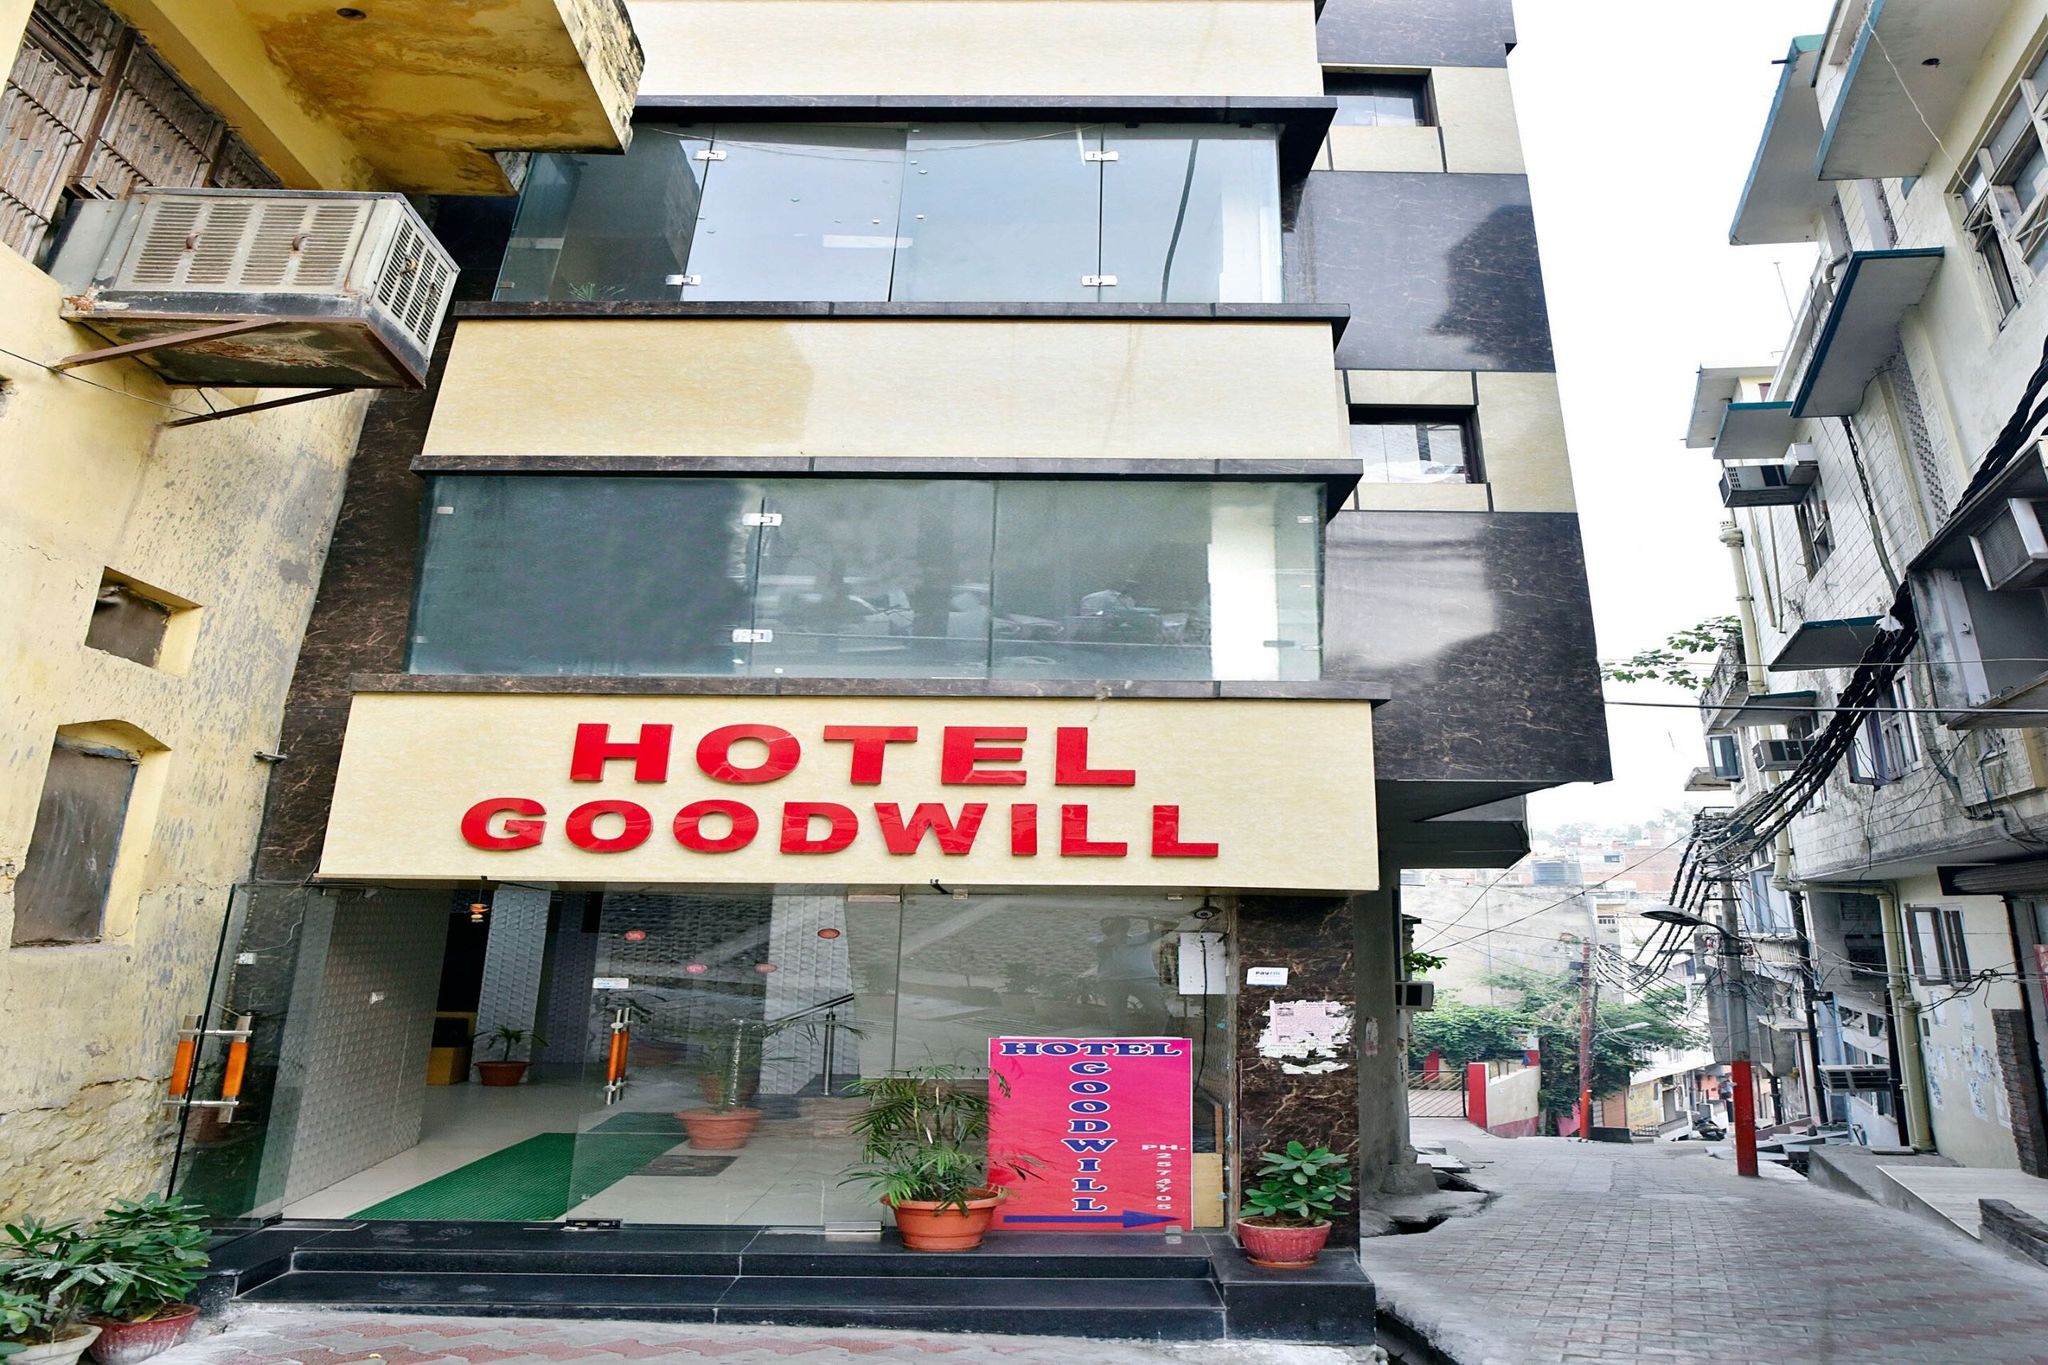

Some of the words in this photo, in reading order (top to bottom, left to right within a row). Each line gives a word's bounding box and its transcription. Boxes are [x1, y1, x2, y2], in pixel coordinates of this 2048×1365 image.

[569, 722, 1136, 786] HOTEL
[460, 796, 1220, 858] GOODWILL
[999, 1041, 1183, 1057] HOTEL
[1062, 1061, 1117, 1212] GOODWILL
